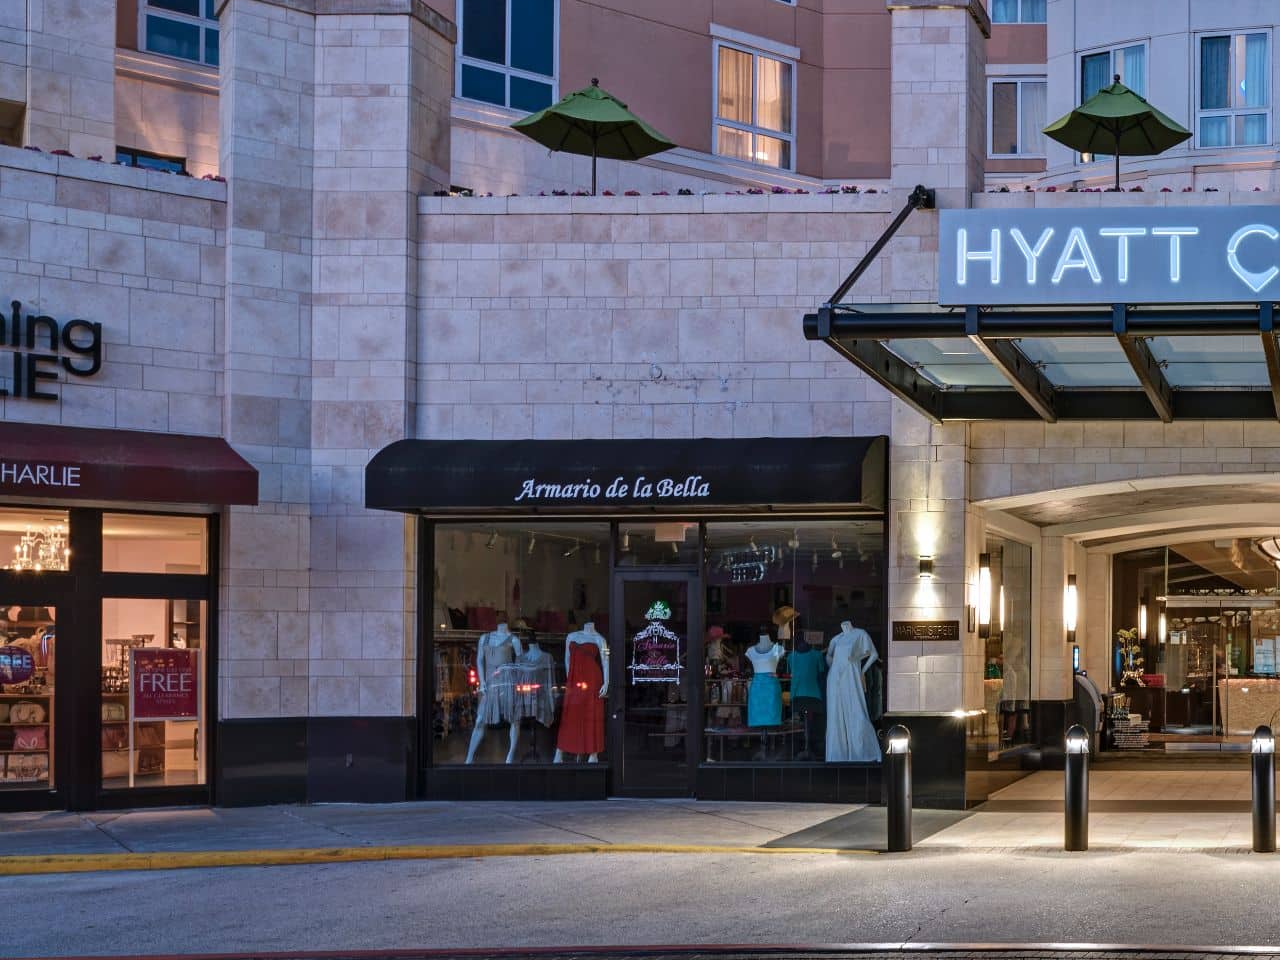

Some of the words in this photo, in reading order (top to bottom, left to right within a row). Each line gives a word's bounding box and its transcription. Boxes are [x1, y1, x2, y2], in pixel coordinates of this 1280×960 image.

[955, 225, 1198, 285] HYATT
[0, 300, 102, 376] ing
[0, 351, 58, 400] IE
[1, 463, 80, 486] HARLIE
[514, 477, 600, 501] Armario
[605, 476, 628, 498] de
[633, 476, 653, 498] la
[656, 475, 710, 497] Bella
[140, 673, 193, 692] FREE
